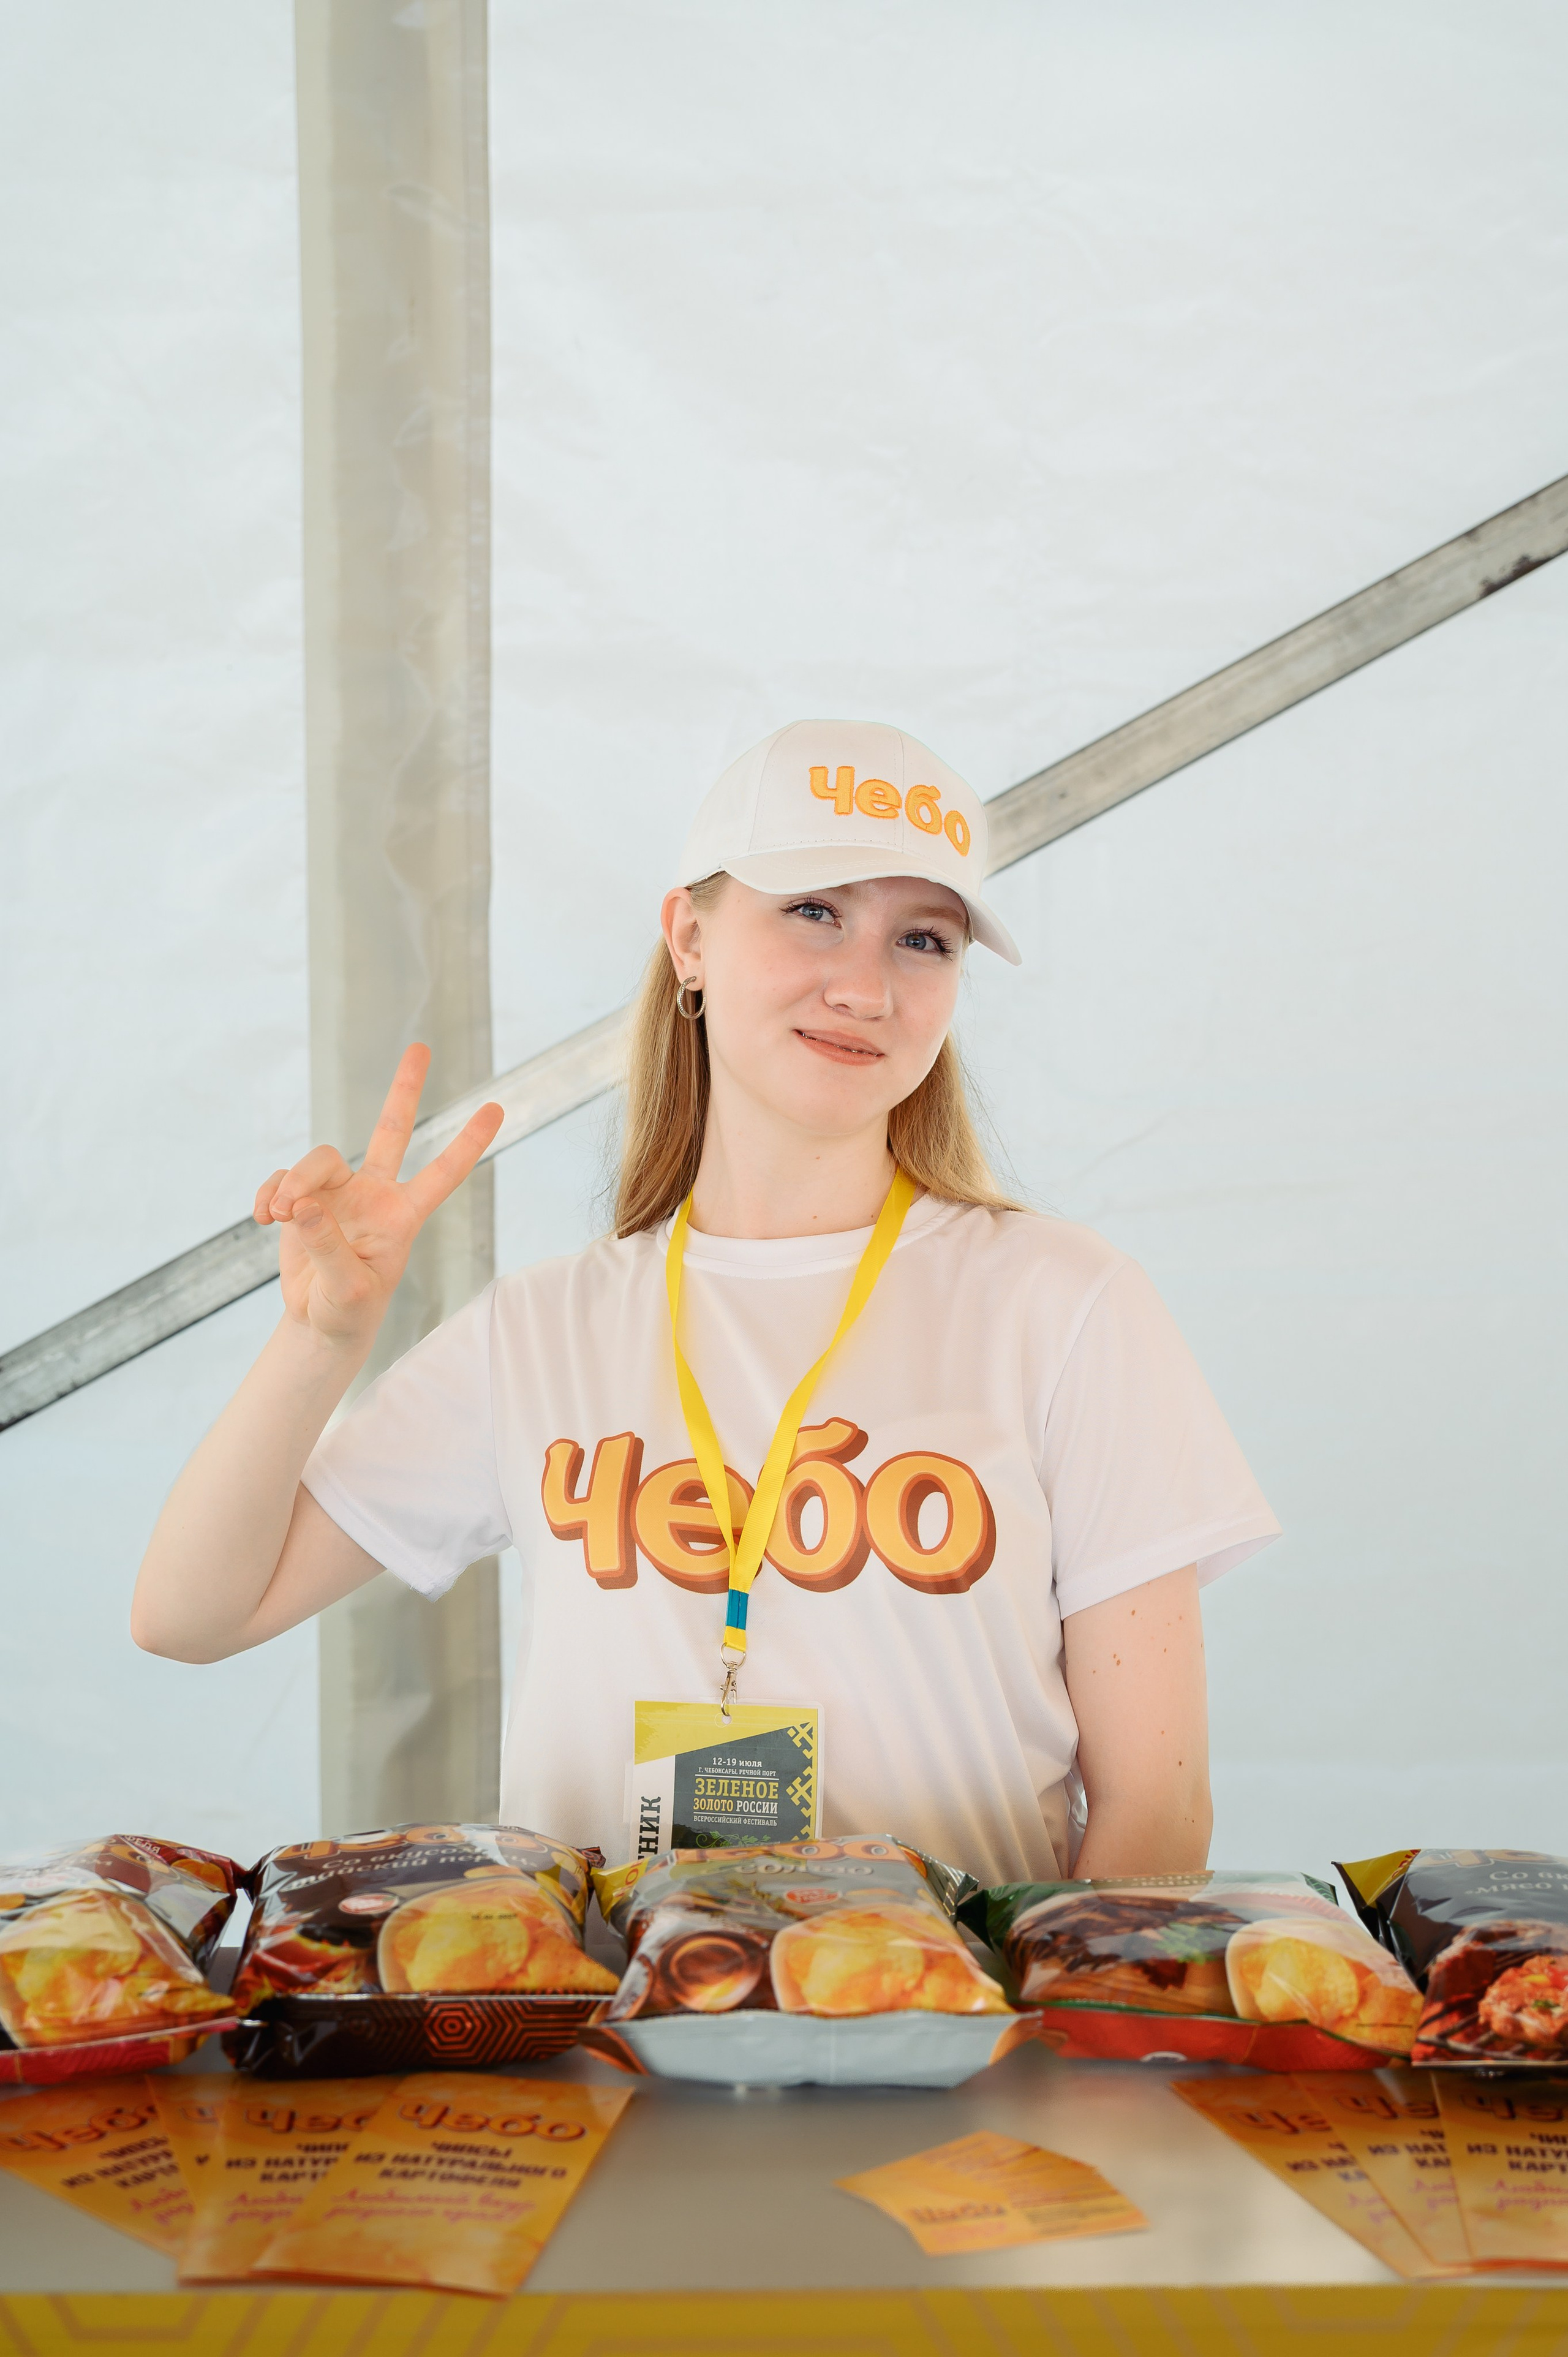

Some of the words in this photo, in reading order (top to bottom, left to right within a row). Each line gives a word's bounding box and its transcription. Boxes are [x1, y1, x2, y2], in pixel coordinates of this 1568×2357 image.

[809, 766, 971, 857] Чебо
[541, 1417, 996, 1594] Чебо
[712, 1757, 736, 1766] 12-19
[695, 1778, 779, 1800] ЗЕЛЕНОЕ
[693, 1798, 734, 1812] ЗОЛОТО
[736, 1800, 778, 1814] РОССИИ
[638, 1796, 662, 1860] НИК
[693, 1815, 742, 1825] ВСЕРОССИЙСКИЙ
[742, 1817, 777, 1827] ФЕСТИВАЛЬ
[322, 1856, 360, 1870] Со
[1490, 1871, 1528, 1880] Со
[398, 2101, 588, 2142] Чебо
